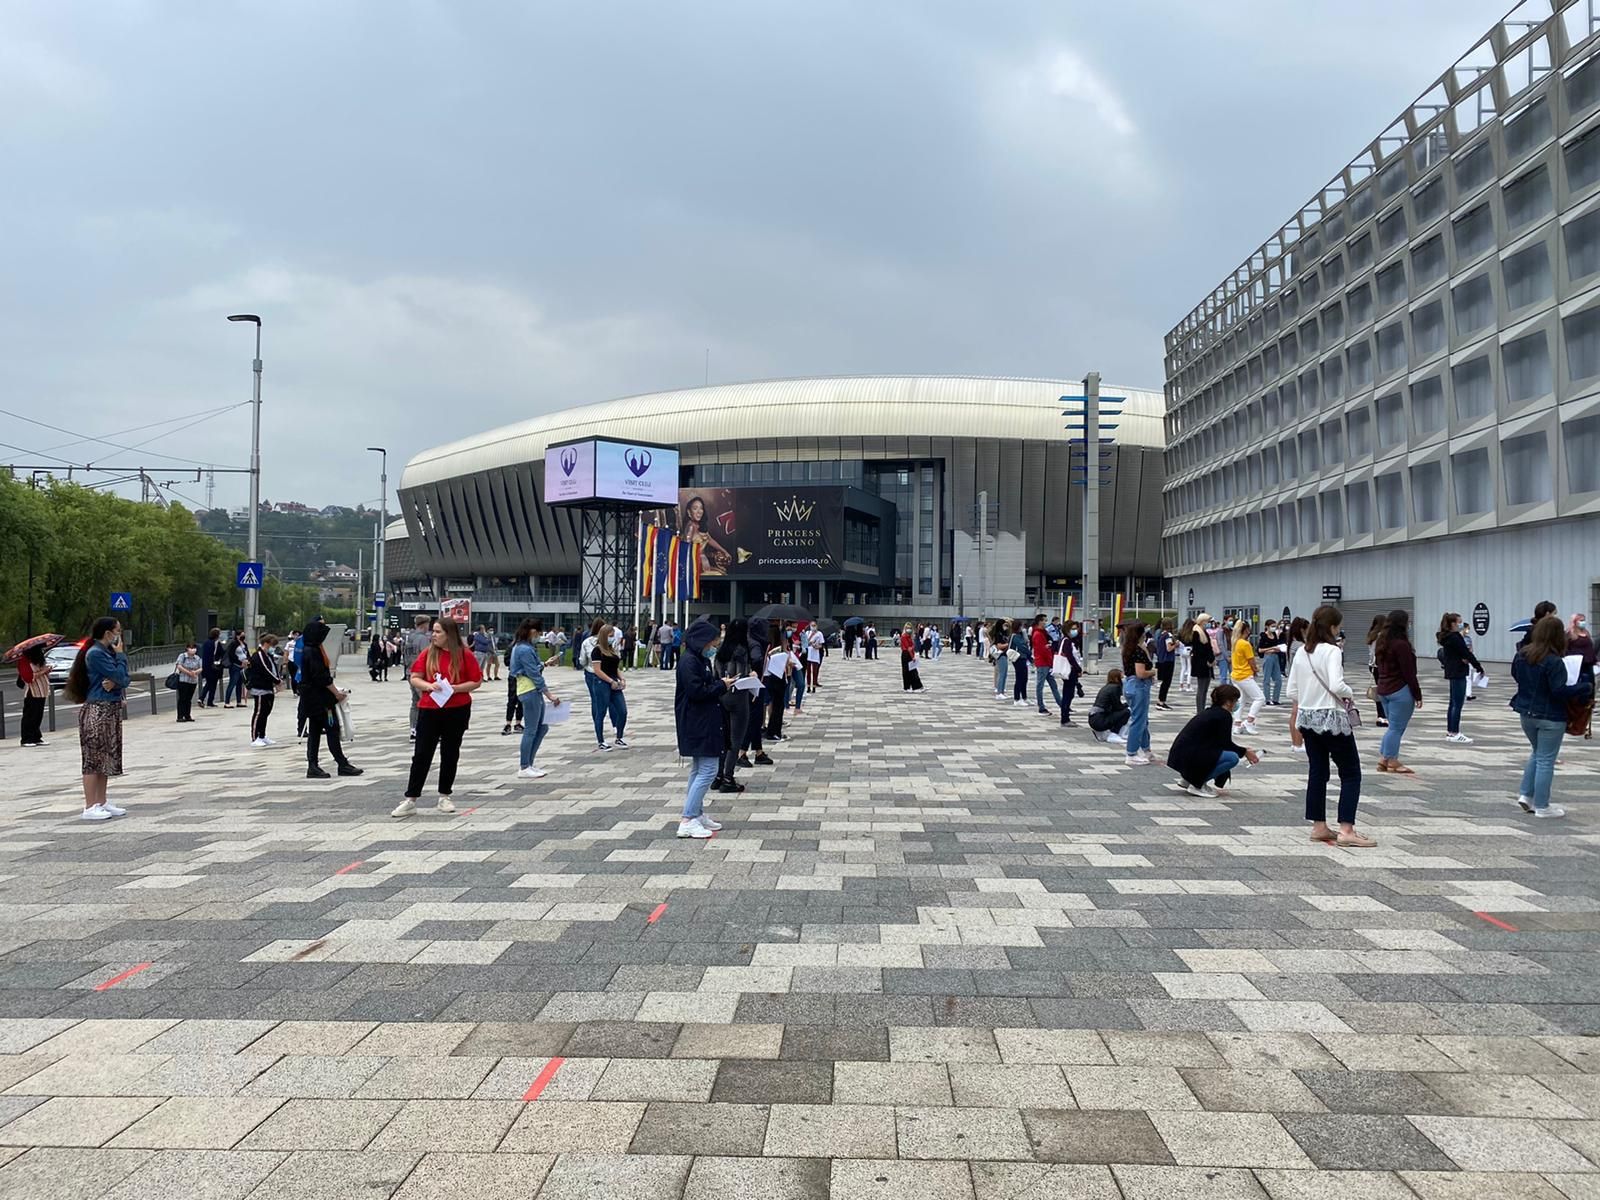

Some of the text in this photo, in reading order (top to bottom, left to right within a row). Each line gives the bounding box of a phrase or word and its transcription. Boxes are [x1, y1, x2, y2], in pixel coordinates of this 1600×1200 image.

[767, 529, 821, 537] PRINCESS
[773, 538, 815, 546] CASINO
[758, 557, 829, 566] princesscasino.ro
